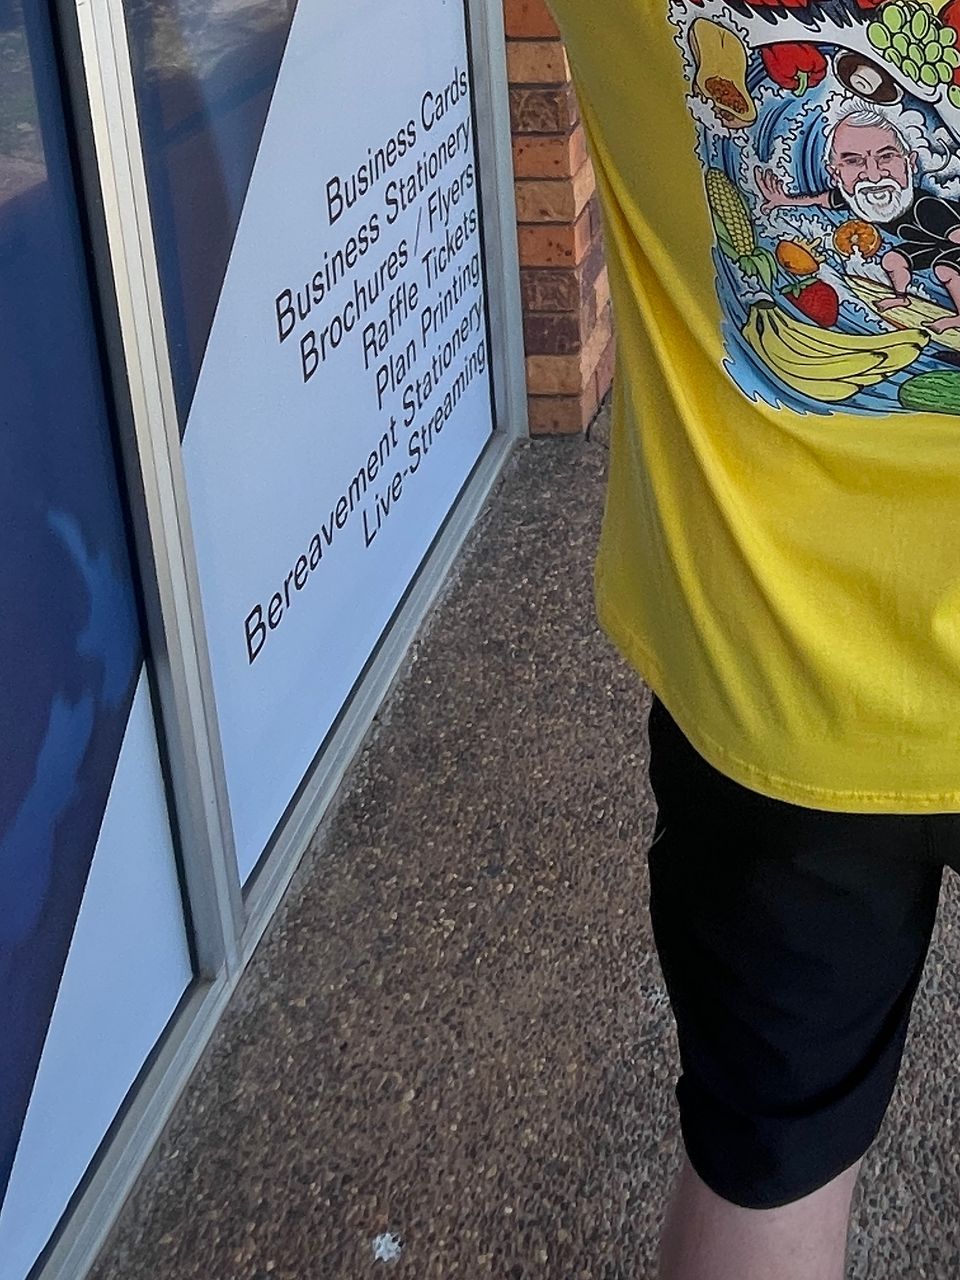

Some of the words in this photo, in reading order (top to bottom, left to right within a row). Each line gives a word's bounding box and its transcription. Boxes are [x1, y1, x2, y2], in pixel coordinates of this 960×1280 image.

[275, 213, 380, 344] Business
[385, 116, 471, 225] Stationery
[326, 119, 416, 226] Business
[421, 66, 468, 132] Cards
[300, 239, 409, 384] Brochures
[428, 163, 474, 234] Flyers
[362, 282, 419, 370] Raffle
[421, 208, 477, 289] Tickets
[375, 339, 417, 410] Plan
[421, 252, 480, 349] Printing
[244, 415, 399, 666] Bereavement
[402, 294, 482, 427] Stationery
[361, 338, 486, 549] Live-Streaming
